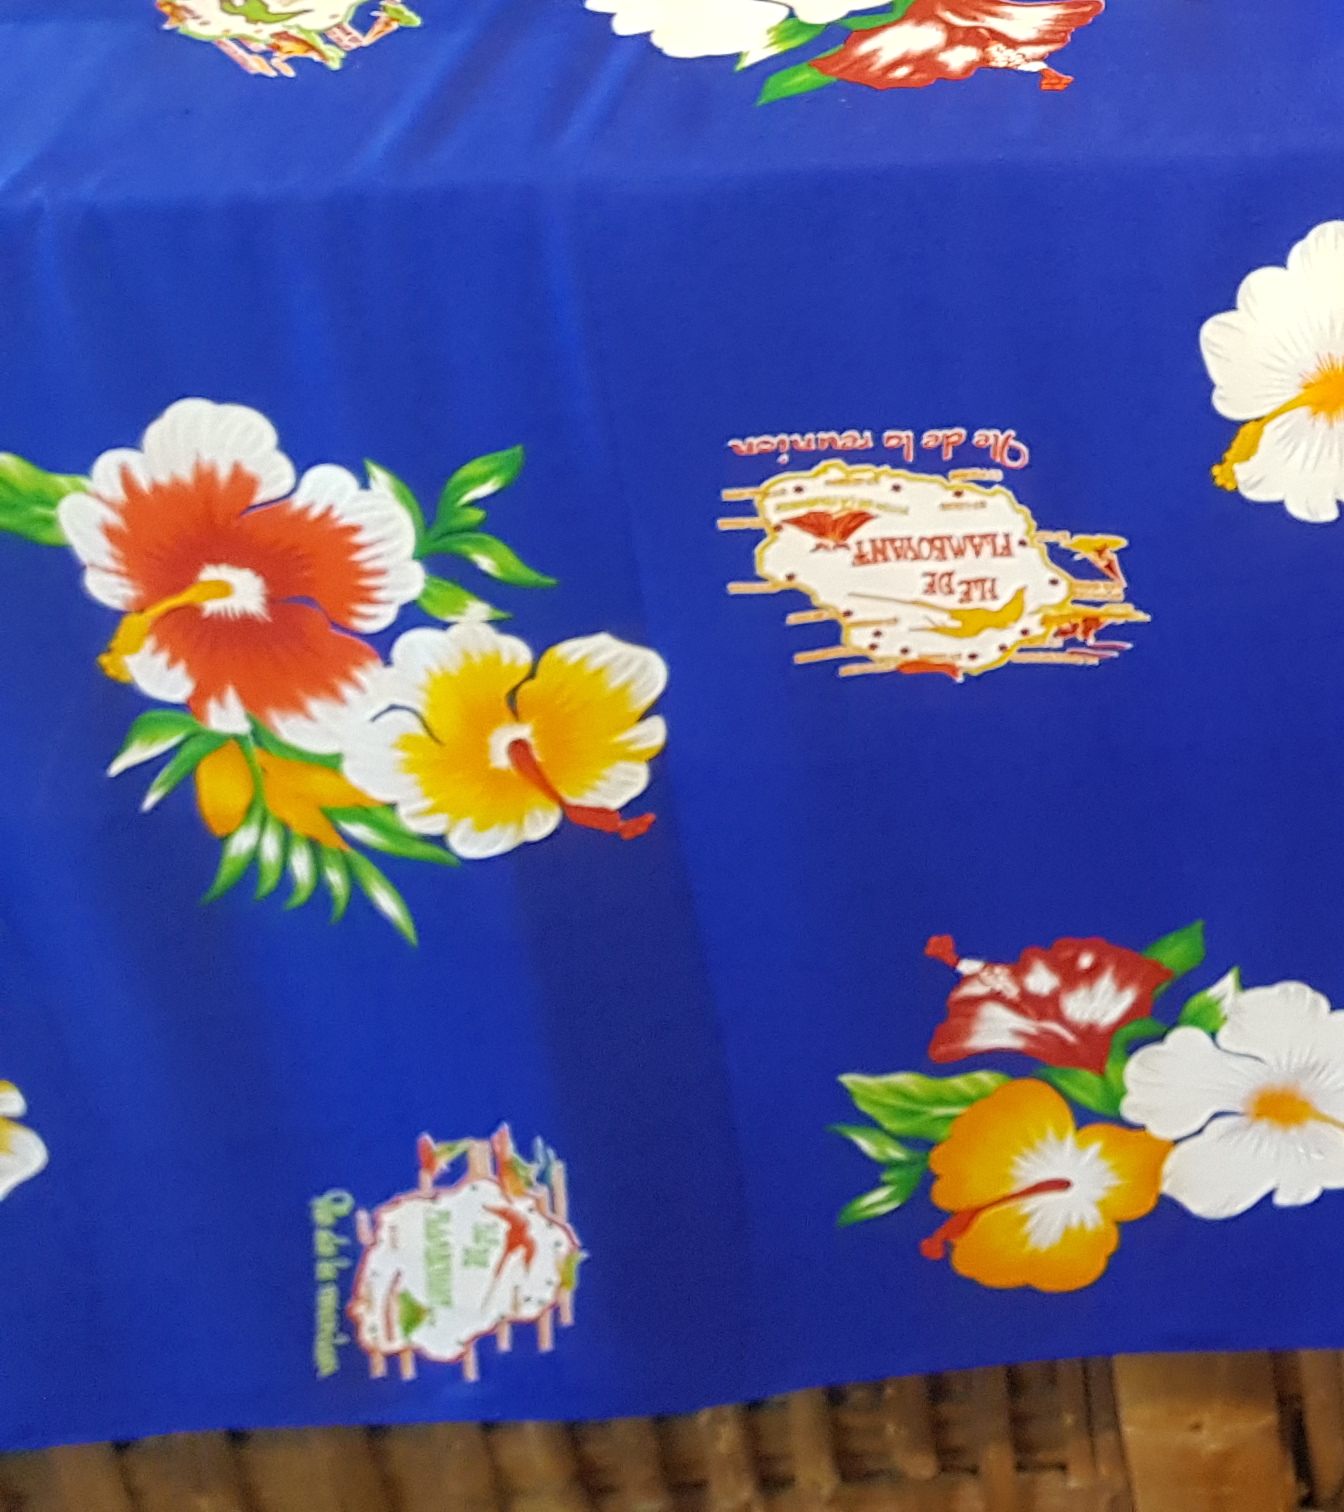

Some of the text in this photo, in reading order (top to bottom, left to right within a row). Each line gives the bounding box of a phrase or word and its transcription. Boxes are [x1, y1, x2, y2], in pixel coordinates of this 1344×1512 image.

[729, 430, 874, 464] reunion
[883, 429, 914, 462] la
[922, 429, 966, 461] de
[852, 531, 1014, 567] FLAMBOYANT
[922, 571, 999, 604] ILE DE
